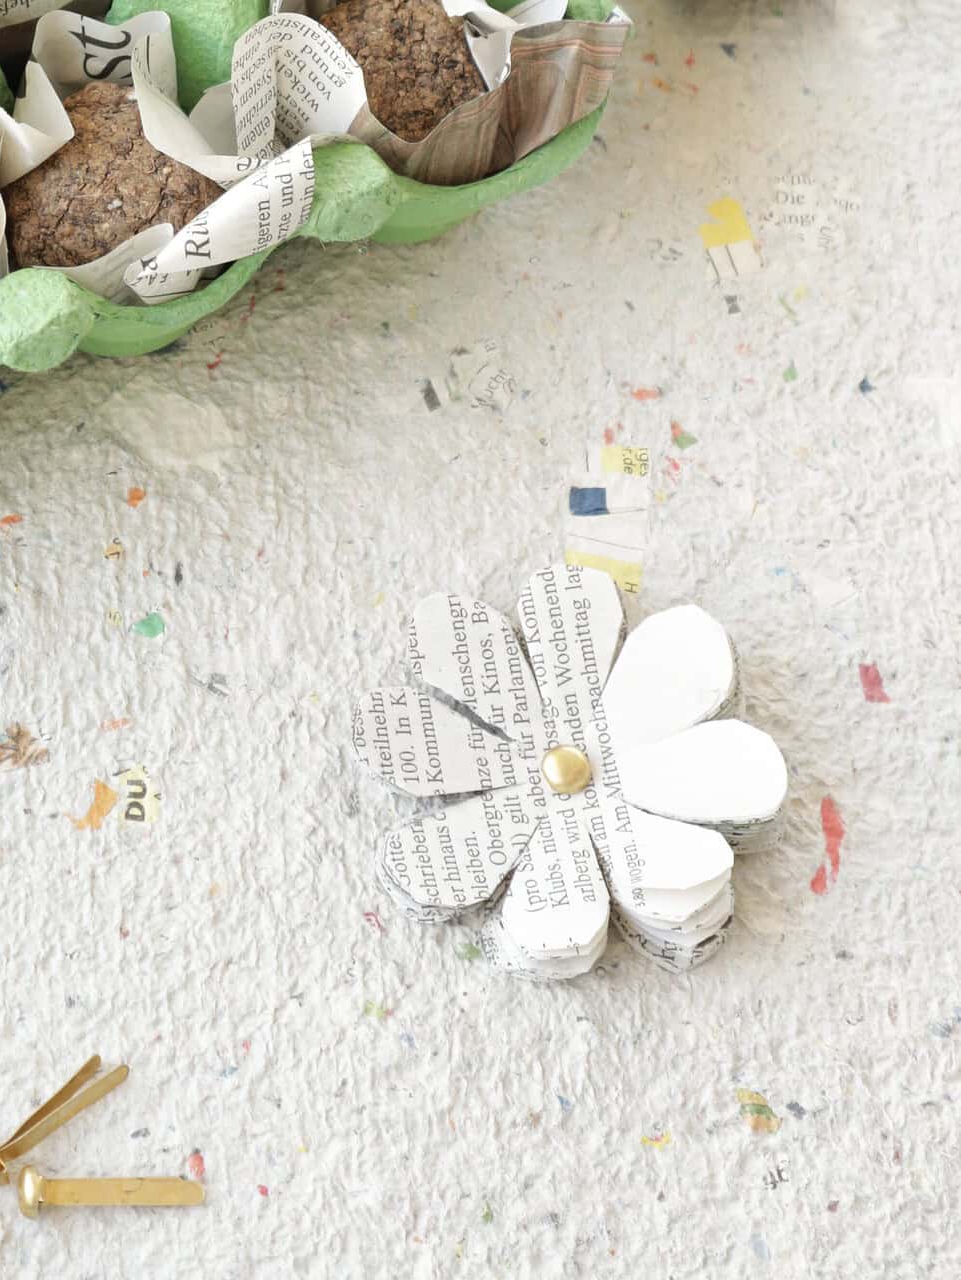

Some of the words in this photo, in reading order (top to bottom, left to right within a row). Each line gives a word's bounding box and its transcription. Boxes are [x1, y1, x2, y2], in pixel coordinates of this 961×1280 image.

[275, 173, 294, 207] und
[480, 633, 501, 695] Kinos,
[467, 719, 486, 749] für
[516, 731, 537, 760] für
[399, 746, 420, 783] 100.
[496, 740, 519, 789] auch
[527, 764, 547, 807] aber
[473, 757, 507, 867] Obergrenze
[505, 795, 530, 824] gilt
[557, 808, 580, 844] wird
[615, 802, 633, 833] Am
[588, 815, 607, 844] am
[436, 826, 461, 882] hinaus
[464, 831, 492, 902] bleiben.
[571, 847, 598, 902] arlberg
